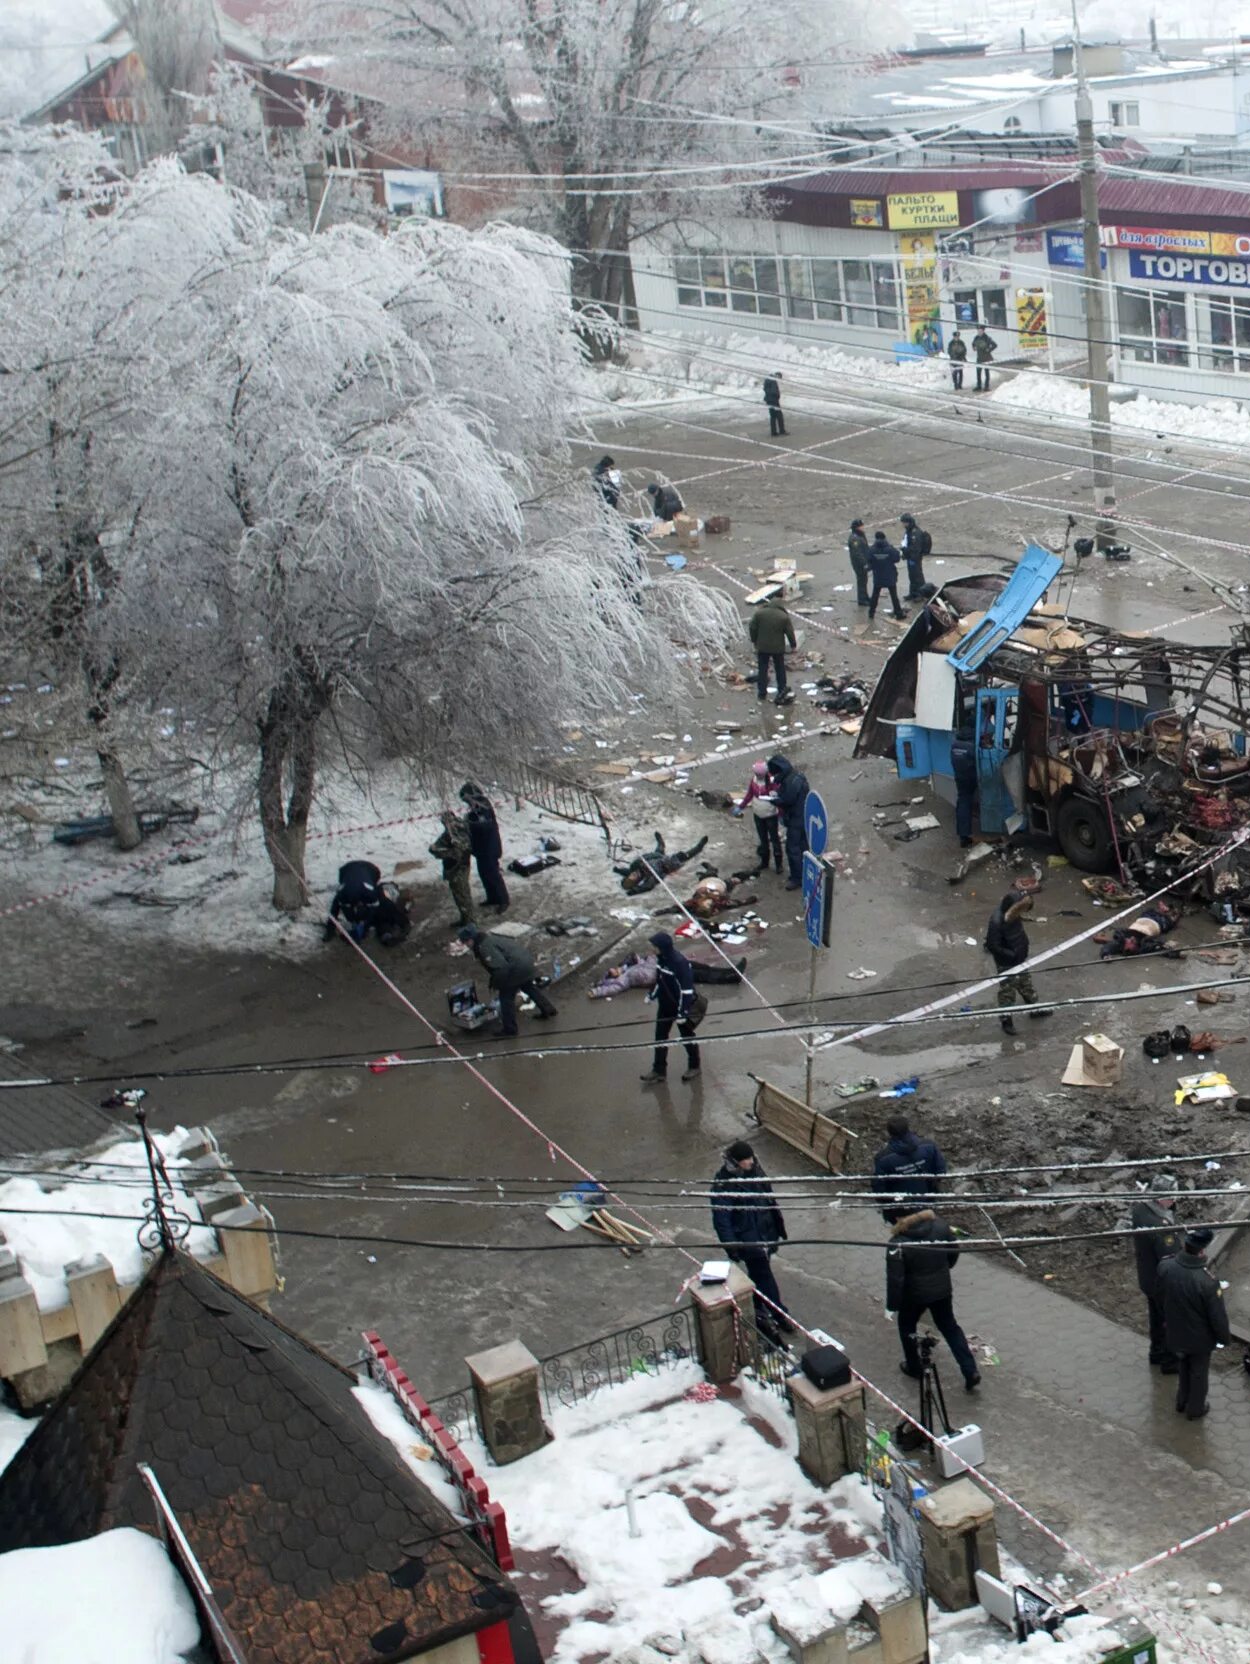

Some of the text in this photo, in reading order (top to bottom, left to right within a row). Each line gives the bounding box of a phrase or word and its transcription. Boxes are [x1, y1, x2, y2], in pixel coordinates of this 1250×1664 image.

[888, 195, 935, 205] ПАЛЬТО
[901, 205, 945, 215] КУРТКИ
[914, 214, 958, 224] ПЛАЩИ
[1120, 232, 1207, 249] для взрослых
